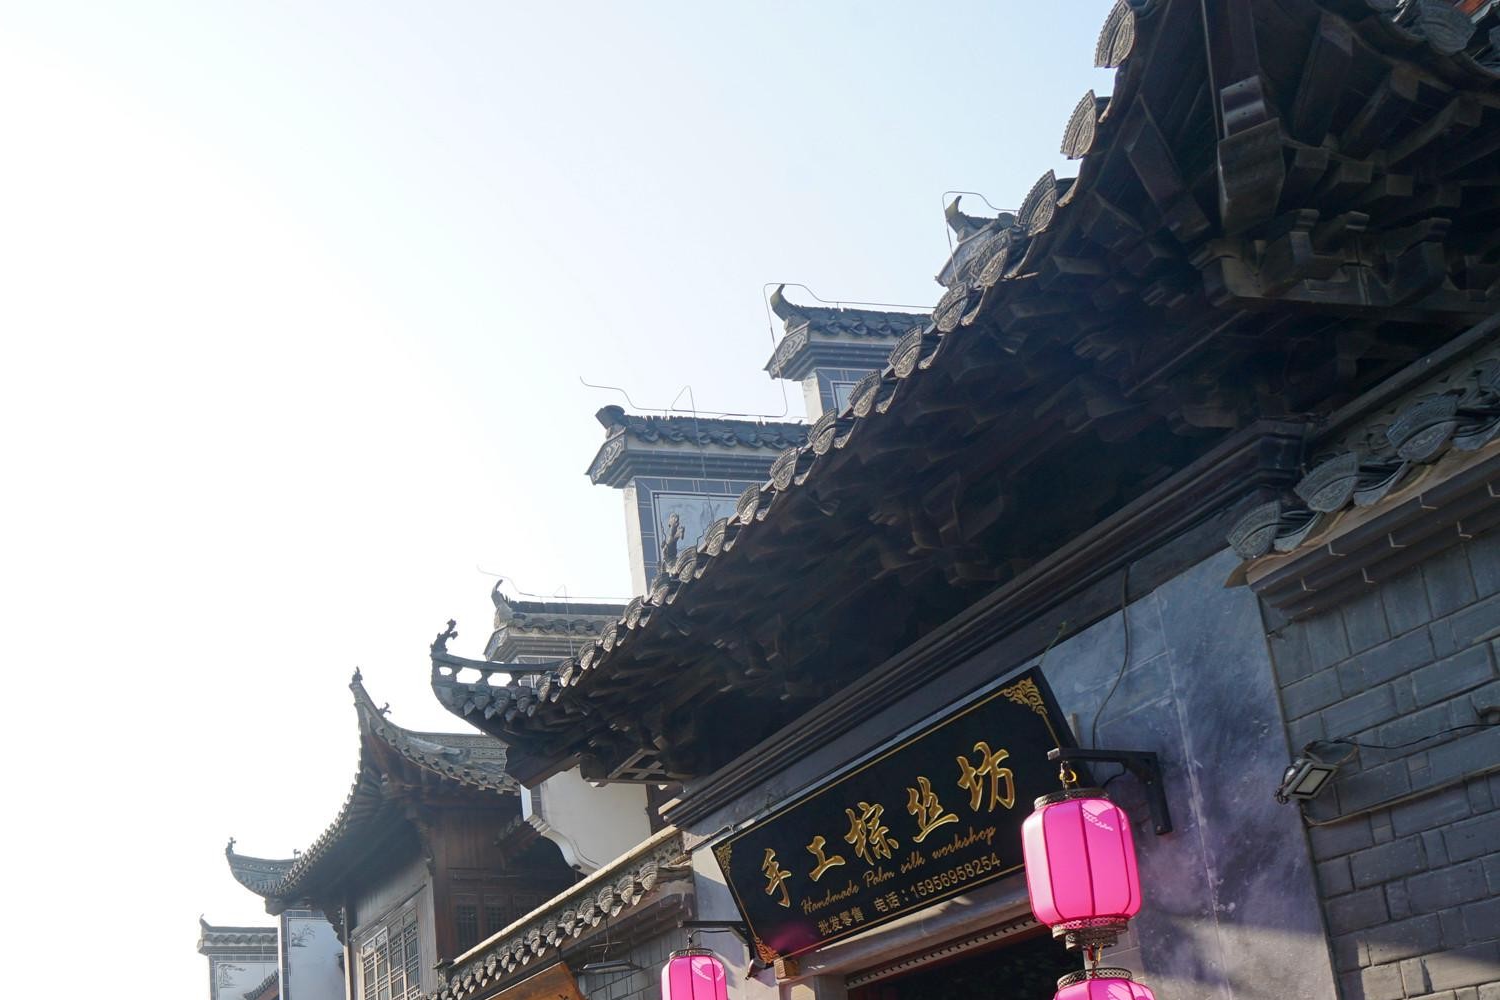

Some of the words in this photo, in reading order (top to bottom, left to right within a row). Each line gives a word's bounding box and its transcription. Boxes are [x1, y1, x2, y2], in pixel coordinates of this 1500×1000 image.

[760, 741, 1017, 907] 手工棕丝坊
[801, 879, 860, 915] Handmade
[865, 865, 896, 889] Palm
[900, 851, 926, 874] silk
[931, 824, 997, 861] workshop
[818, 906, 866, 936] 批发零售
